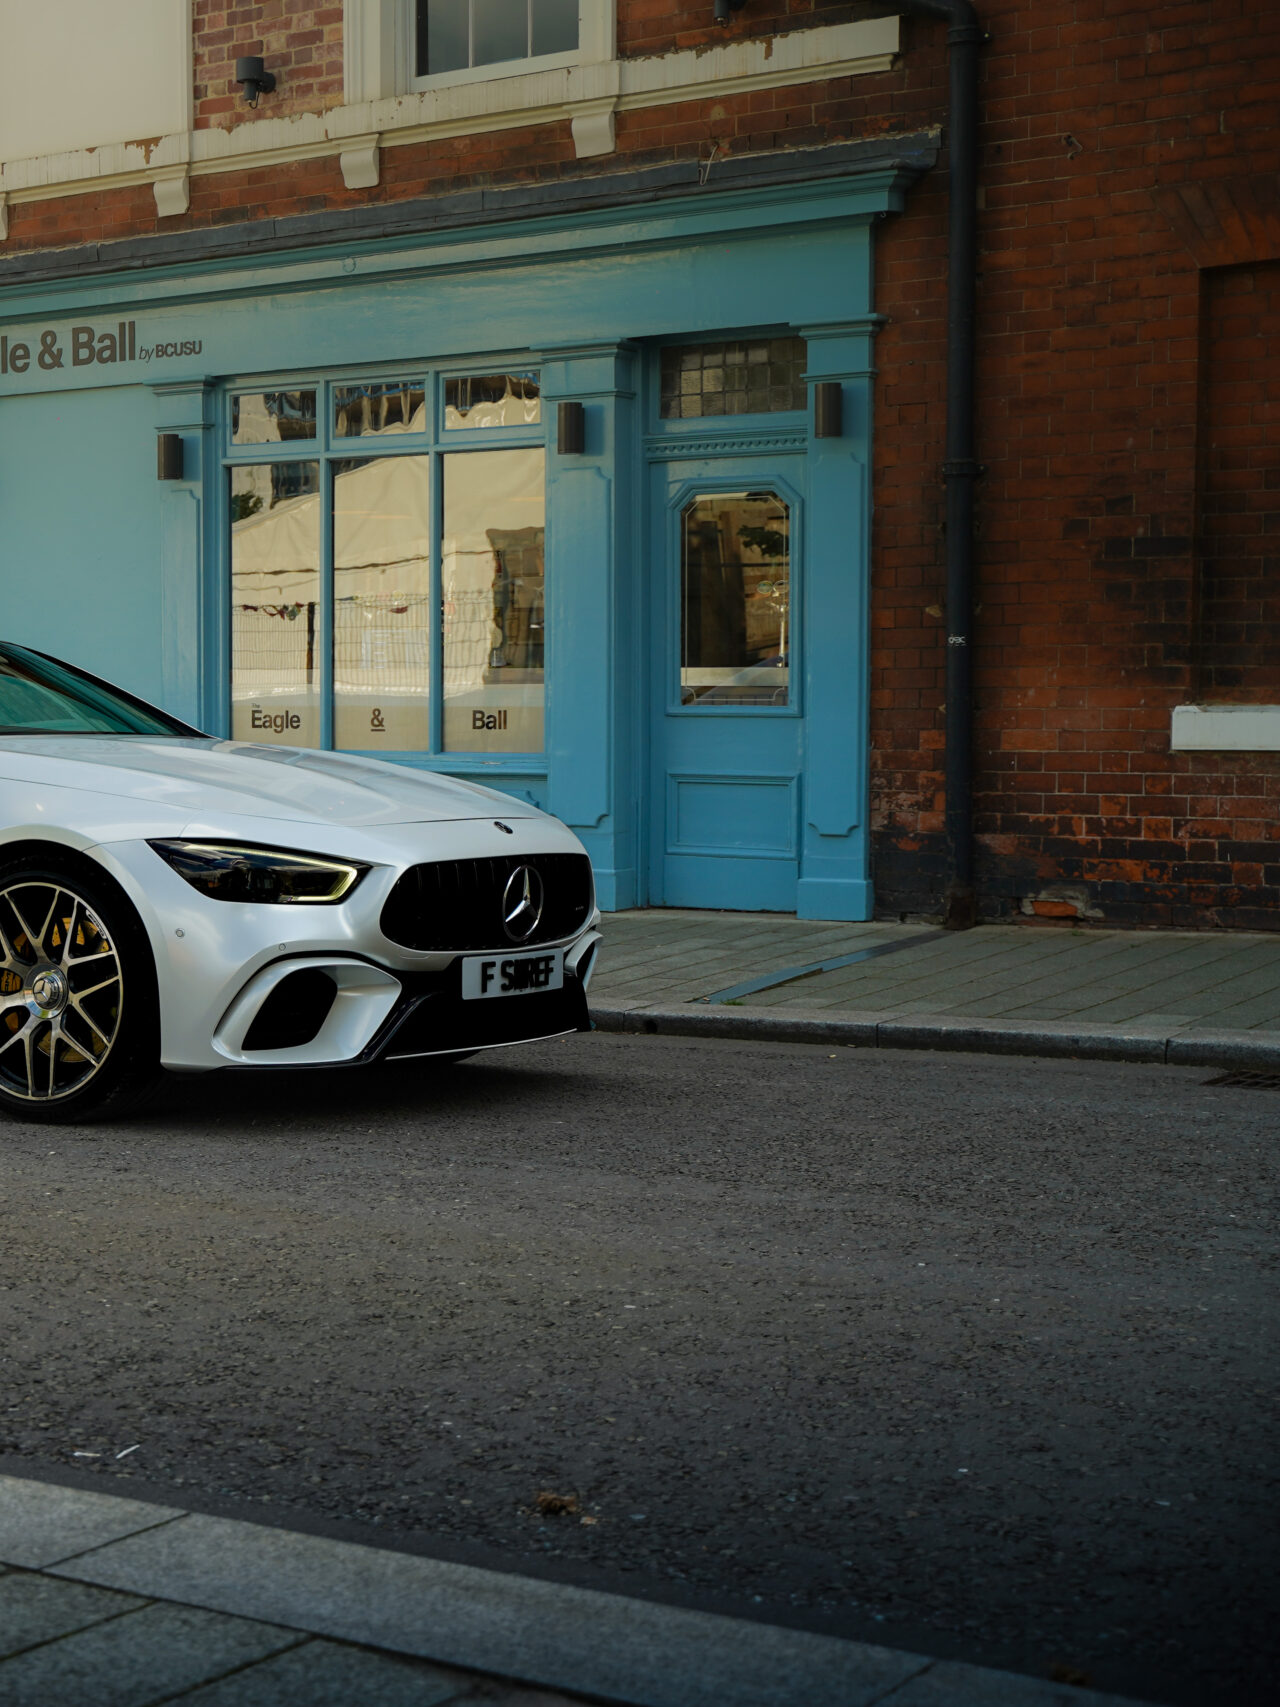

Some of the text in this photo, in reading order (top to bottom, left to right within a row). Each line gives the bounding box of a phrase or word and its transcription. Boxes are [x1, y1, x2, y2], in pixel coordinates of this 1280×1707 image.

[37, 330, 64, 370] &
[72, 321, 136, 367] Ball
[139, 345, 155, 363] by
[155, 340, 203, 358] BCUSU
[251, 708, 508, 734] Eagle & Ball
